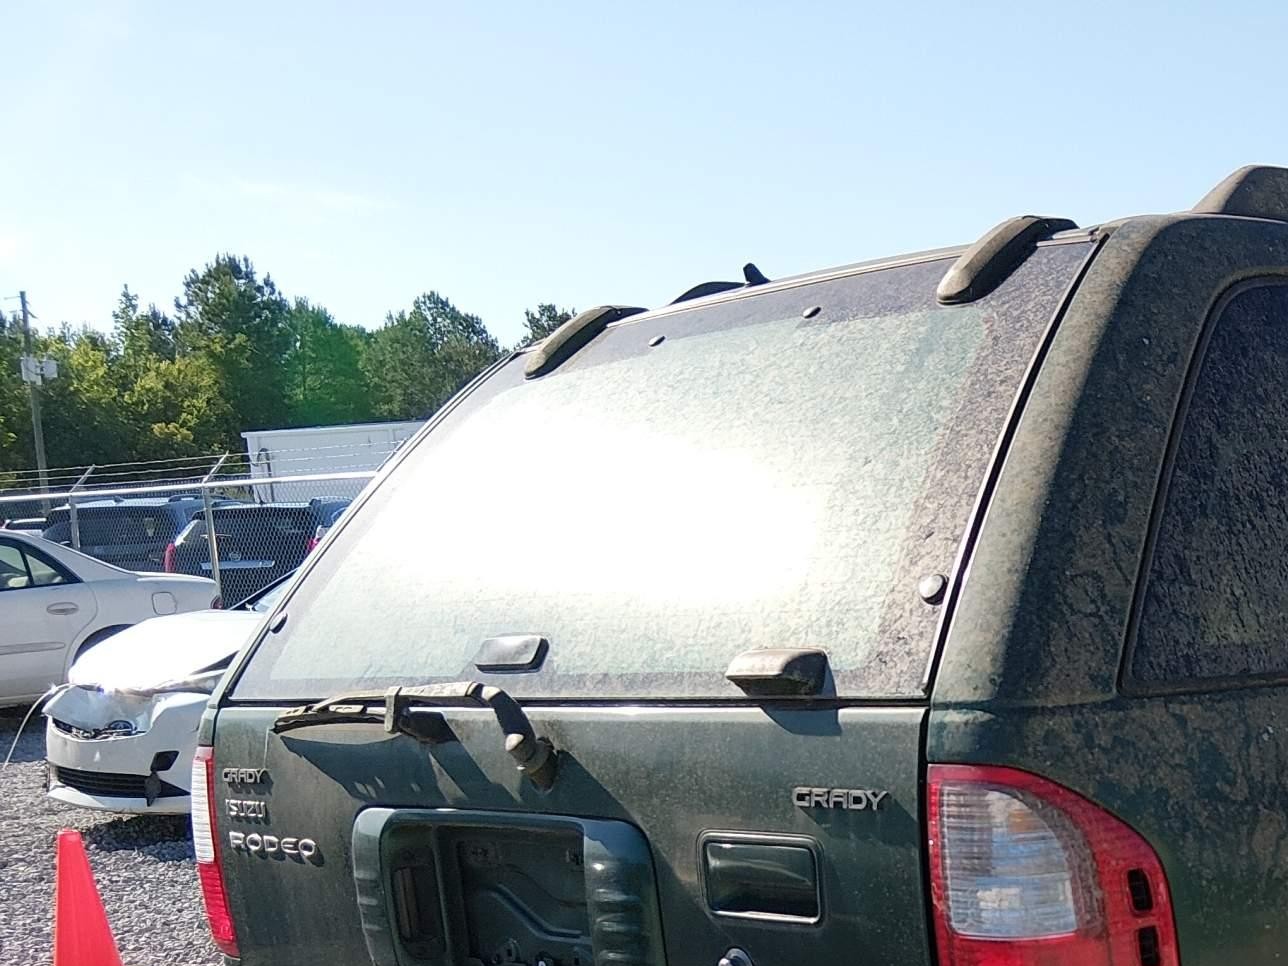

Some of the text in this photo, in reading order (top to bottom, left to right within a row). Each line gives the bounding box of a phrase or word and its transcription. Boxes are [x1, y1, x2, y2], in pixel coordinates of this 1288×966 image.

[222, 767, 266, 783] GRADY
[224, 798, 266, 818] ISUZU
[791, 786, 889, 811] GRADY
[228, 831, 317, 857] RODEO
